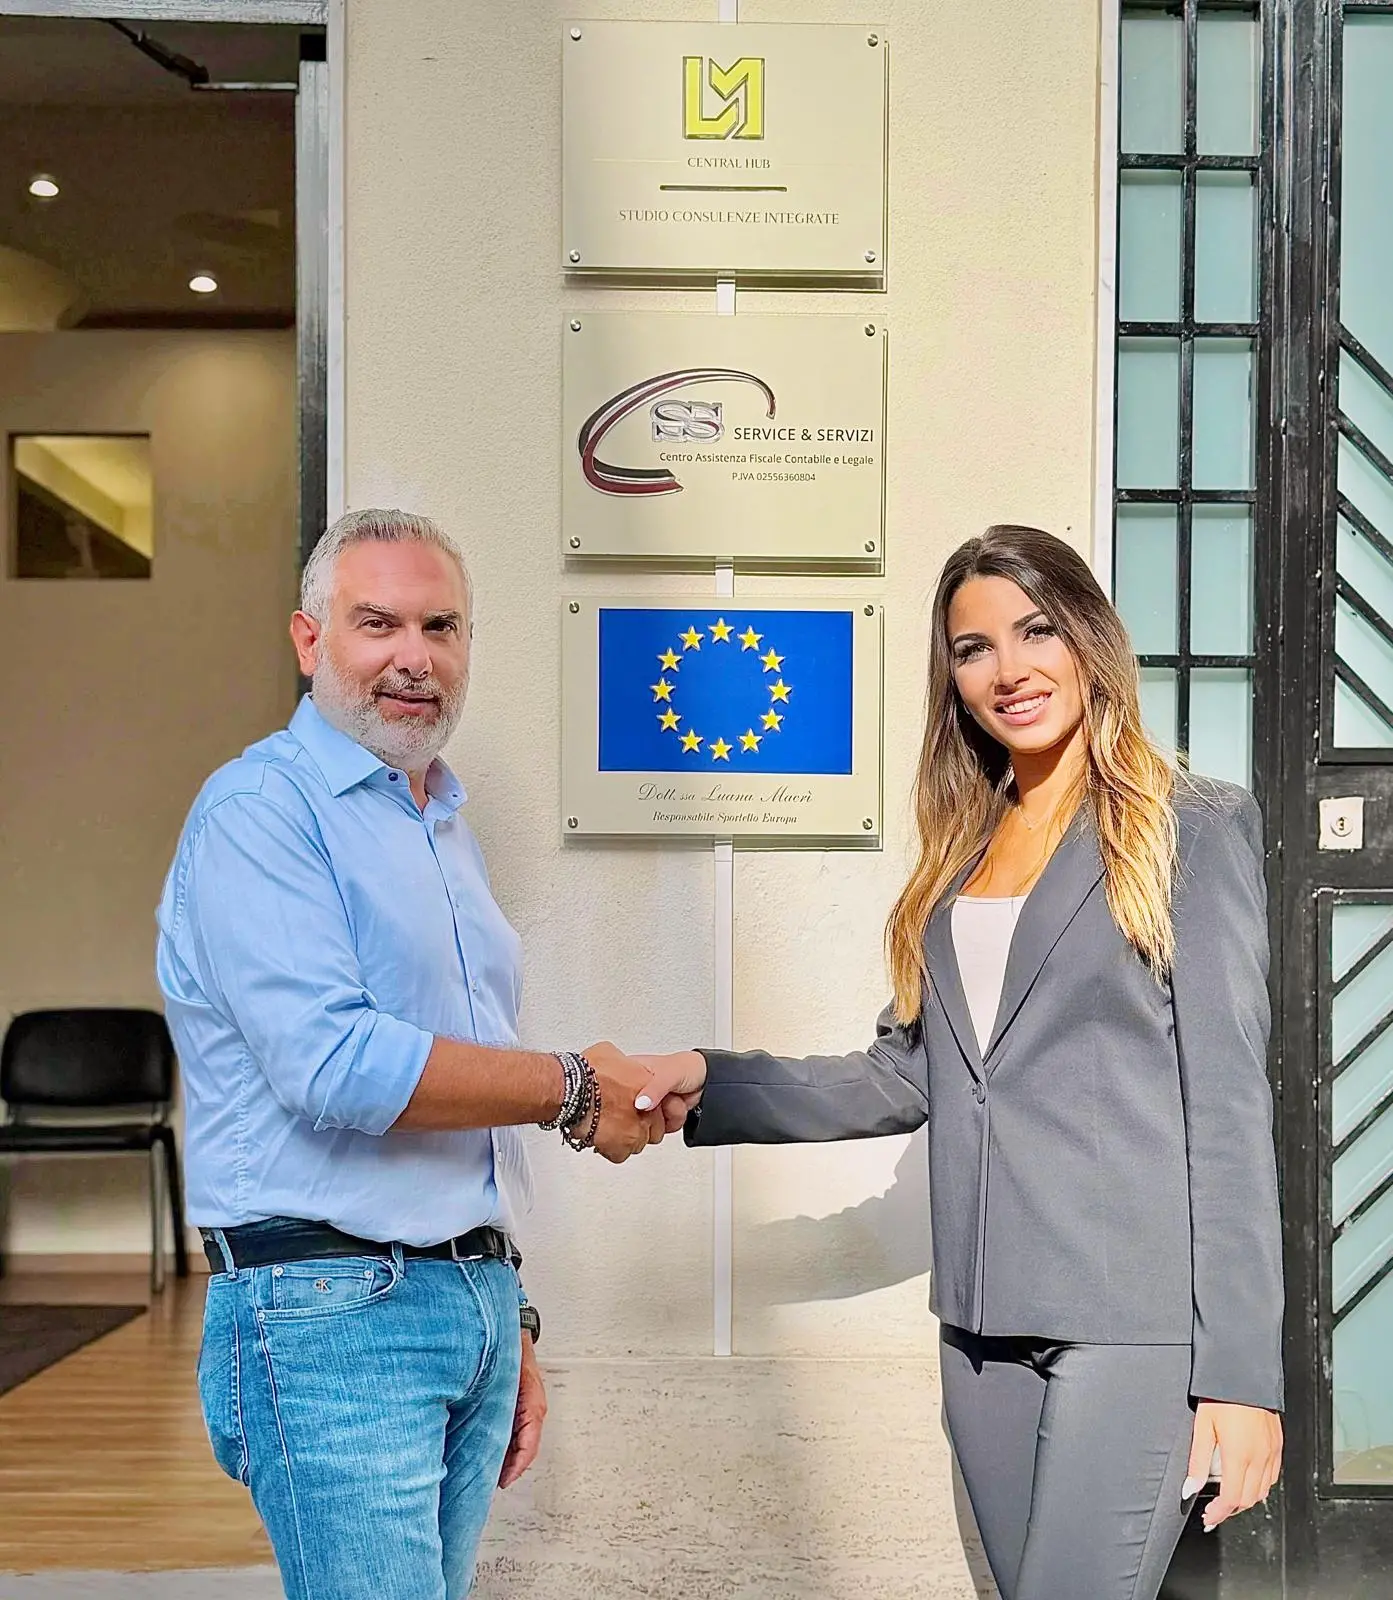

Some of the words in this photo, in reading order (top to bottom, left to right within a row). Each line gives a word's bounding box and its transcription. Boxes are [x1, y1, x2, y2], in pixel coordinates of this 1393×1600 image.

[687, 157, 742, 168] CENTRAL
[745, 158, 771, 169] HUB
[619, 210, 669, 222] STUDIO
[672, 211, 761, 223] CONSULENZE
[764, 212, 840, 225] INTEGRATE
[733, 427, 796, 441] SERVICE
[800, 428, 812, 441] &
[816, 428, 874, 442] SERVIZI
[659, 452, 693, 462] Centro
[695, 453, 747, 464] Assistenza
[749, 453, 782, 464] Fiscale
[784, 454, 831, 464] Contabile
[833, 456, 840, 465] e
[842, 455, 874, 467] Legale
[732, 472, 755, 481] P.IVA
[756, 472, 816, 482] 02556360804
[680, 792, 696, 801] ssa
[701, 783, 754, 802] Luana
[653, 811, 714, 823] Responsabile
[717, 812, 759, 824] Sportello
[762, 813, 798, 825] Europa
